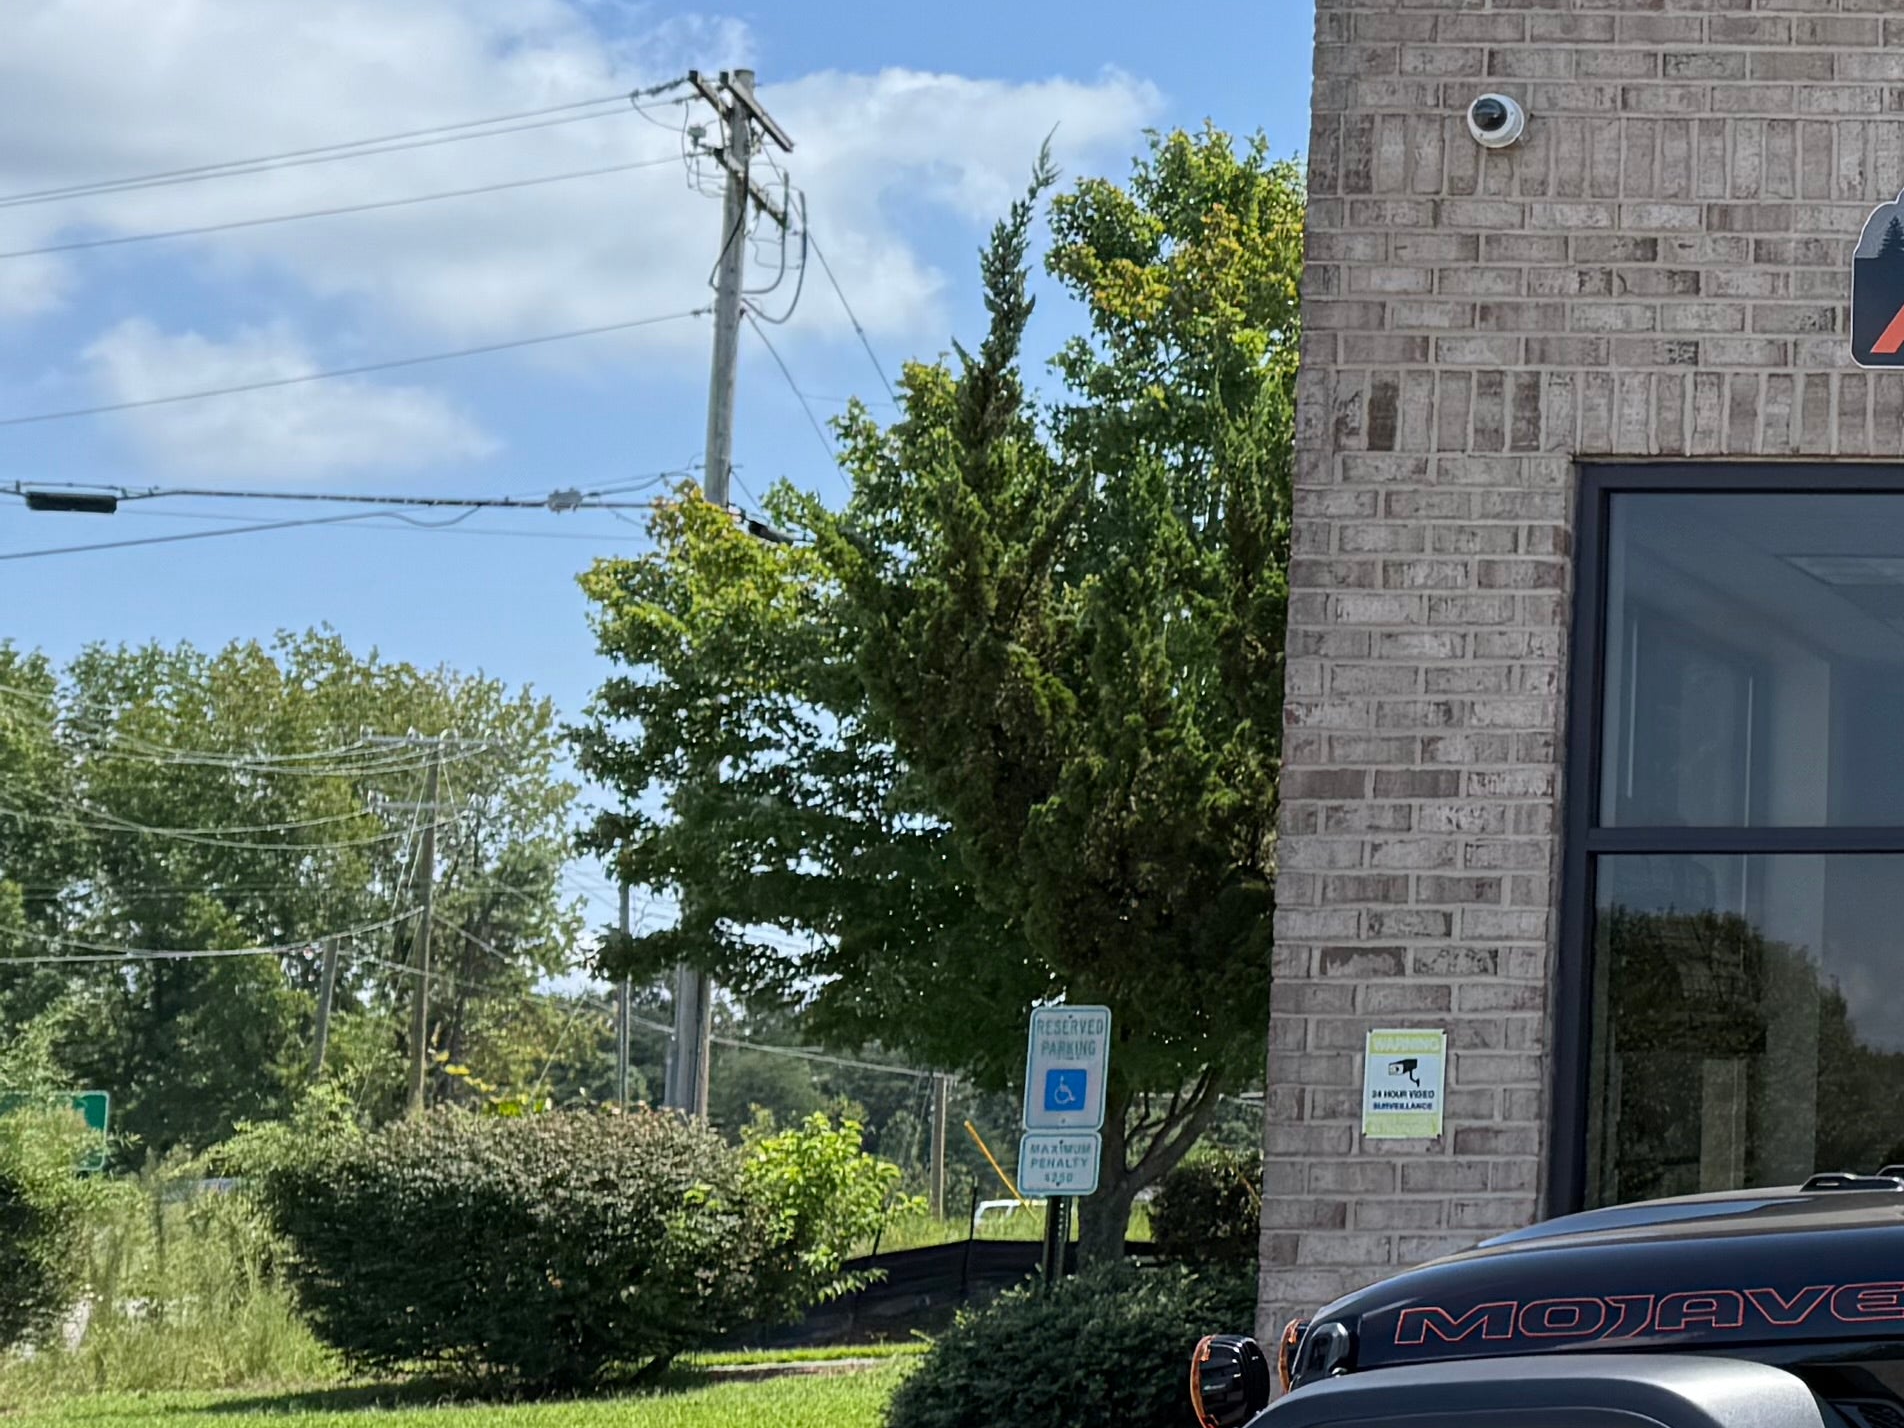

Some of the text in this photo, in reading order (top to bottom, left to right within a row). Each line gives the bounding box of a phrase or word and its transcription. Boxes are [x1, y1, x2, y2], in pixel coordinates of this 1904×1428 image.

[1036, 1018, 1103, 1037] RESERVED
[1041, 1040, 1096, 1057] PARKING
[1384, 1090, 1408, 1099] HOUR
[1409, 1090, 1435, 1099] VIDEO
[1029, 1143, 1091, 1155] MAXIMUM
[1030, 1157, 1089, 1169] PENALTY
